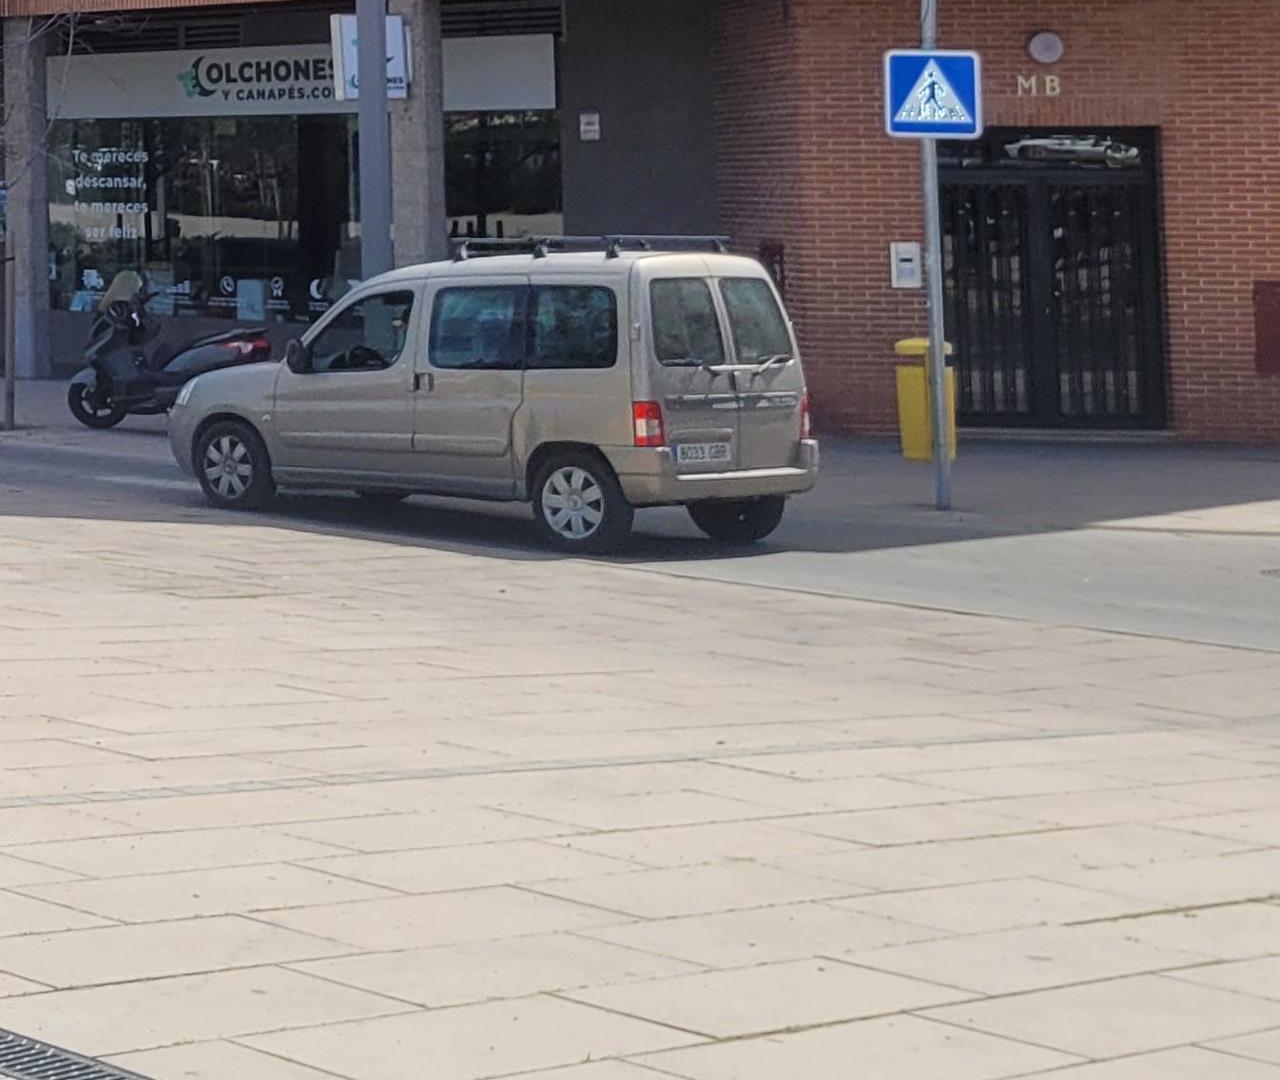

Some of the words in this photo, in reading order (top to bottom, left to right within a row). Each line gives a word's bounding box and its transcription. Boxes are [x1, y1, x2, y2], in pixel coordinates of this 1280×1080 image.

[222, 89, 231, 101] Y
[236, 84, 336, 102] CANAPÉS.CO
[72, 149, 88, 163] Te
[89, 151, 149, 163] mereces
[90, 201, 149, 214] mereces
